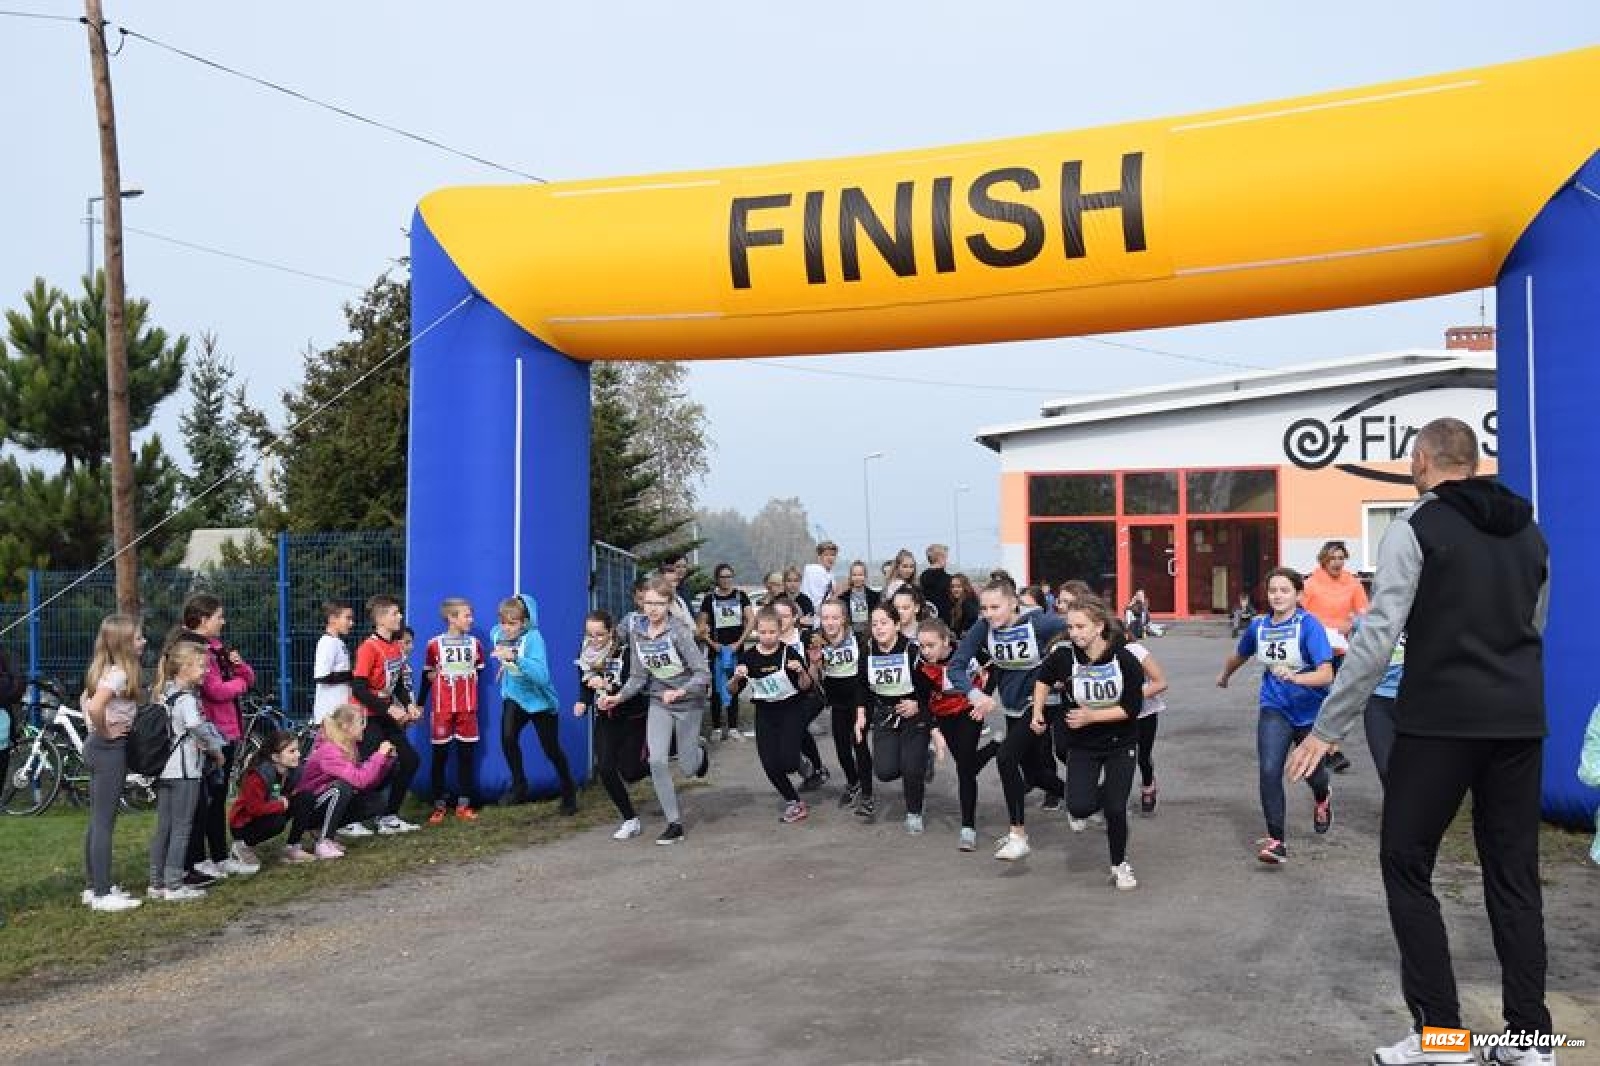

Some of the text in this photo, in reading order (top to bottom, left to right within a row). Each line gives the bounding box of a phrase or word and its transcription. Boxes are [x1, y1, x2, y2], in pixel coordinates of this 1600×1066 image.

[729, 151, 1147, 289] FINISH
[445, 647, 473, 662] 218
[995, 641, 1031, 661] 812
[1265, 641, 1287, 661] 45
[874, 668, 903, 685] 267
[1083, 680, 1117, 701] 100
